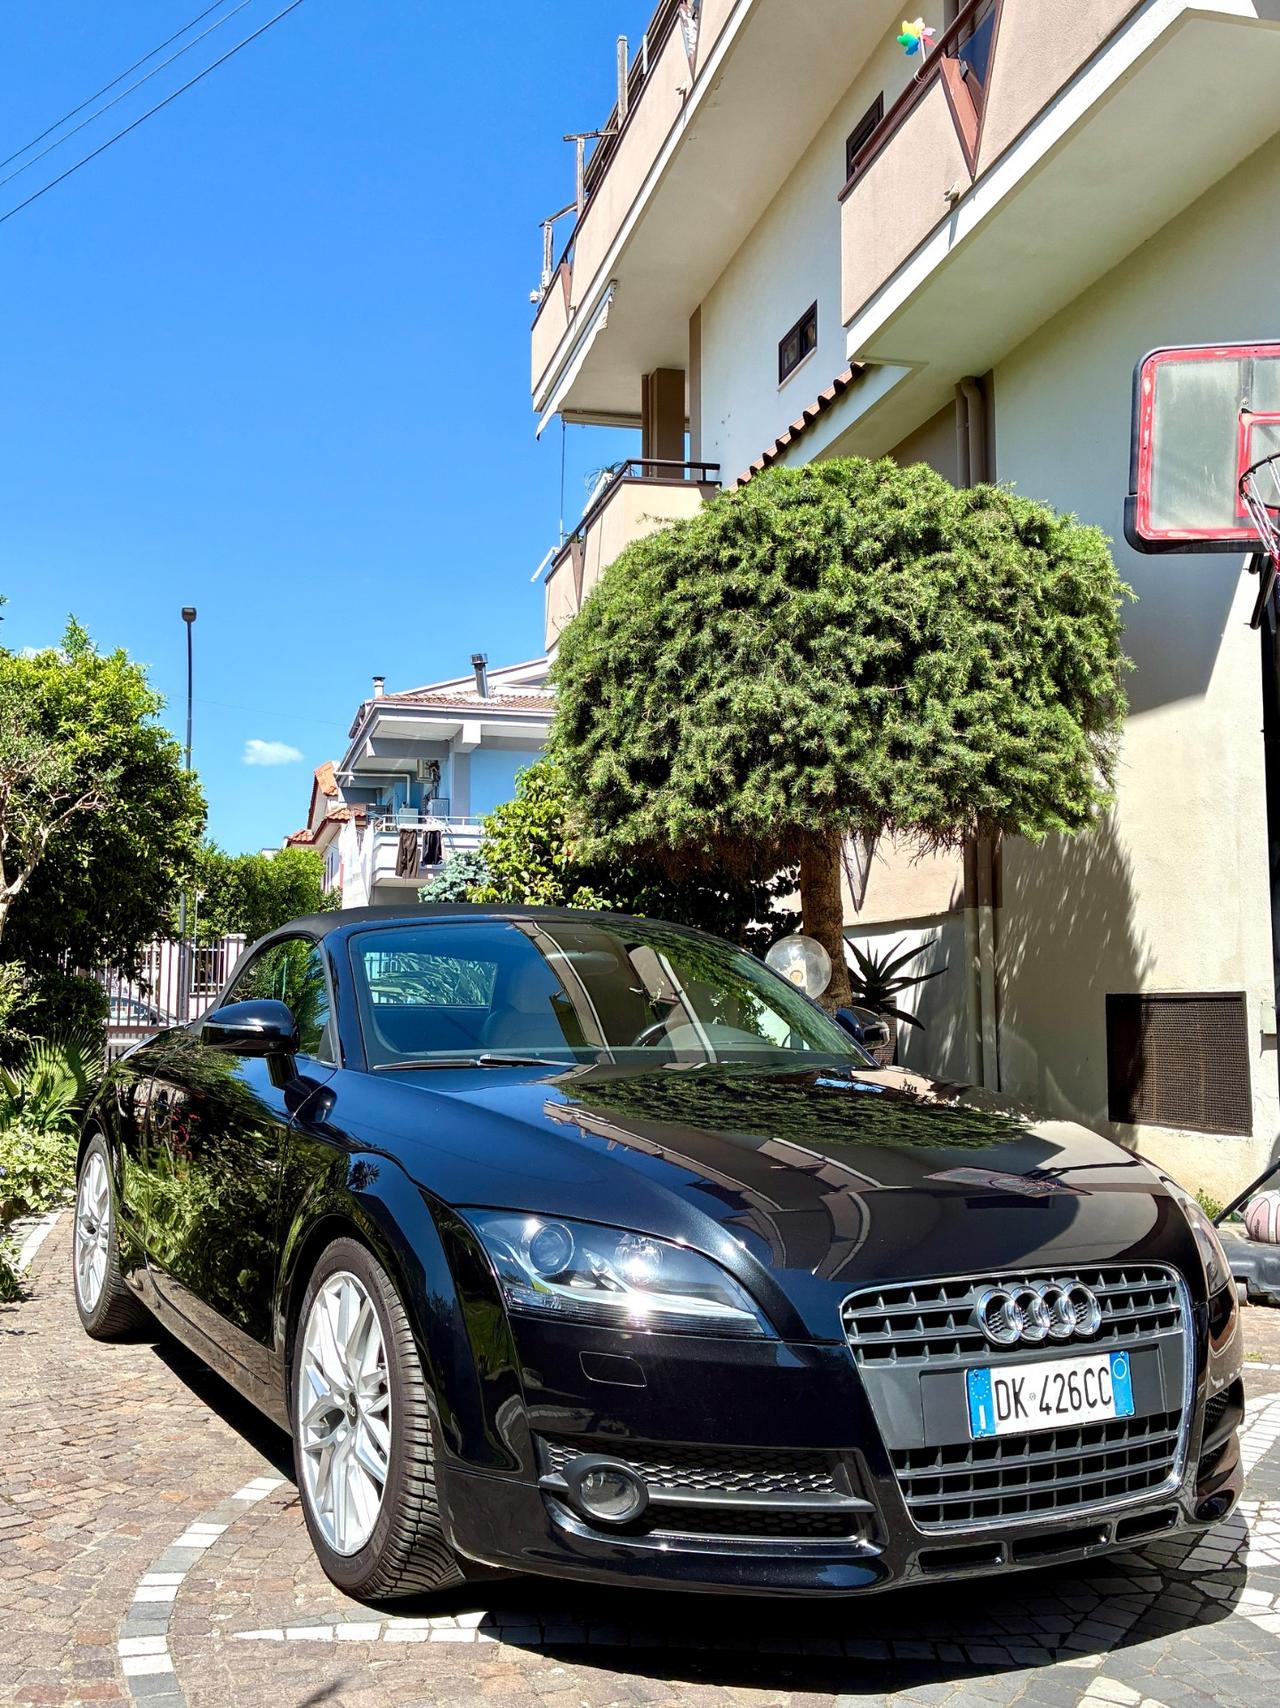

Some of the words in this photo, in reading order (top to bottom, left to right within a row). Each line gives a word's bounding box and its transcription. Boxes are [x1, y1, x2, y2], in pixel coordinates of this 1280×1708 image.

[994, 1377, 1028, 1420] DK
[1039, 1367, 1112, 1415] 426CC
[979, 1405, 987, 1430] I
